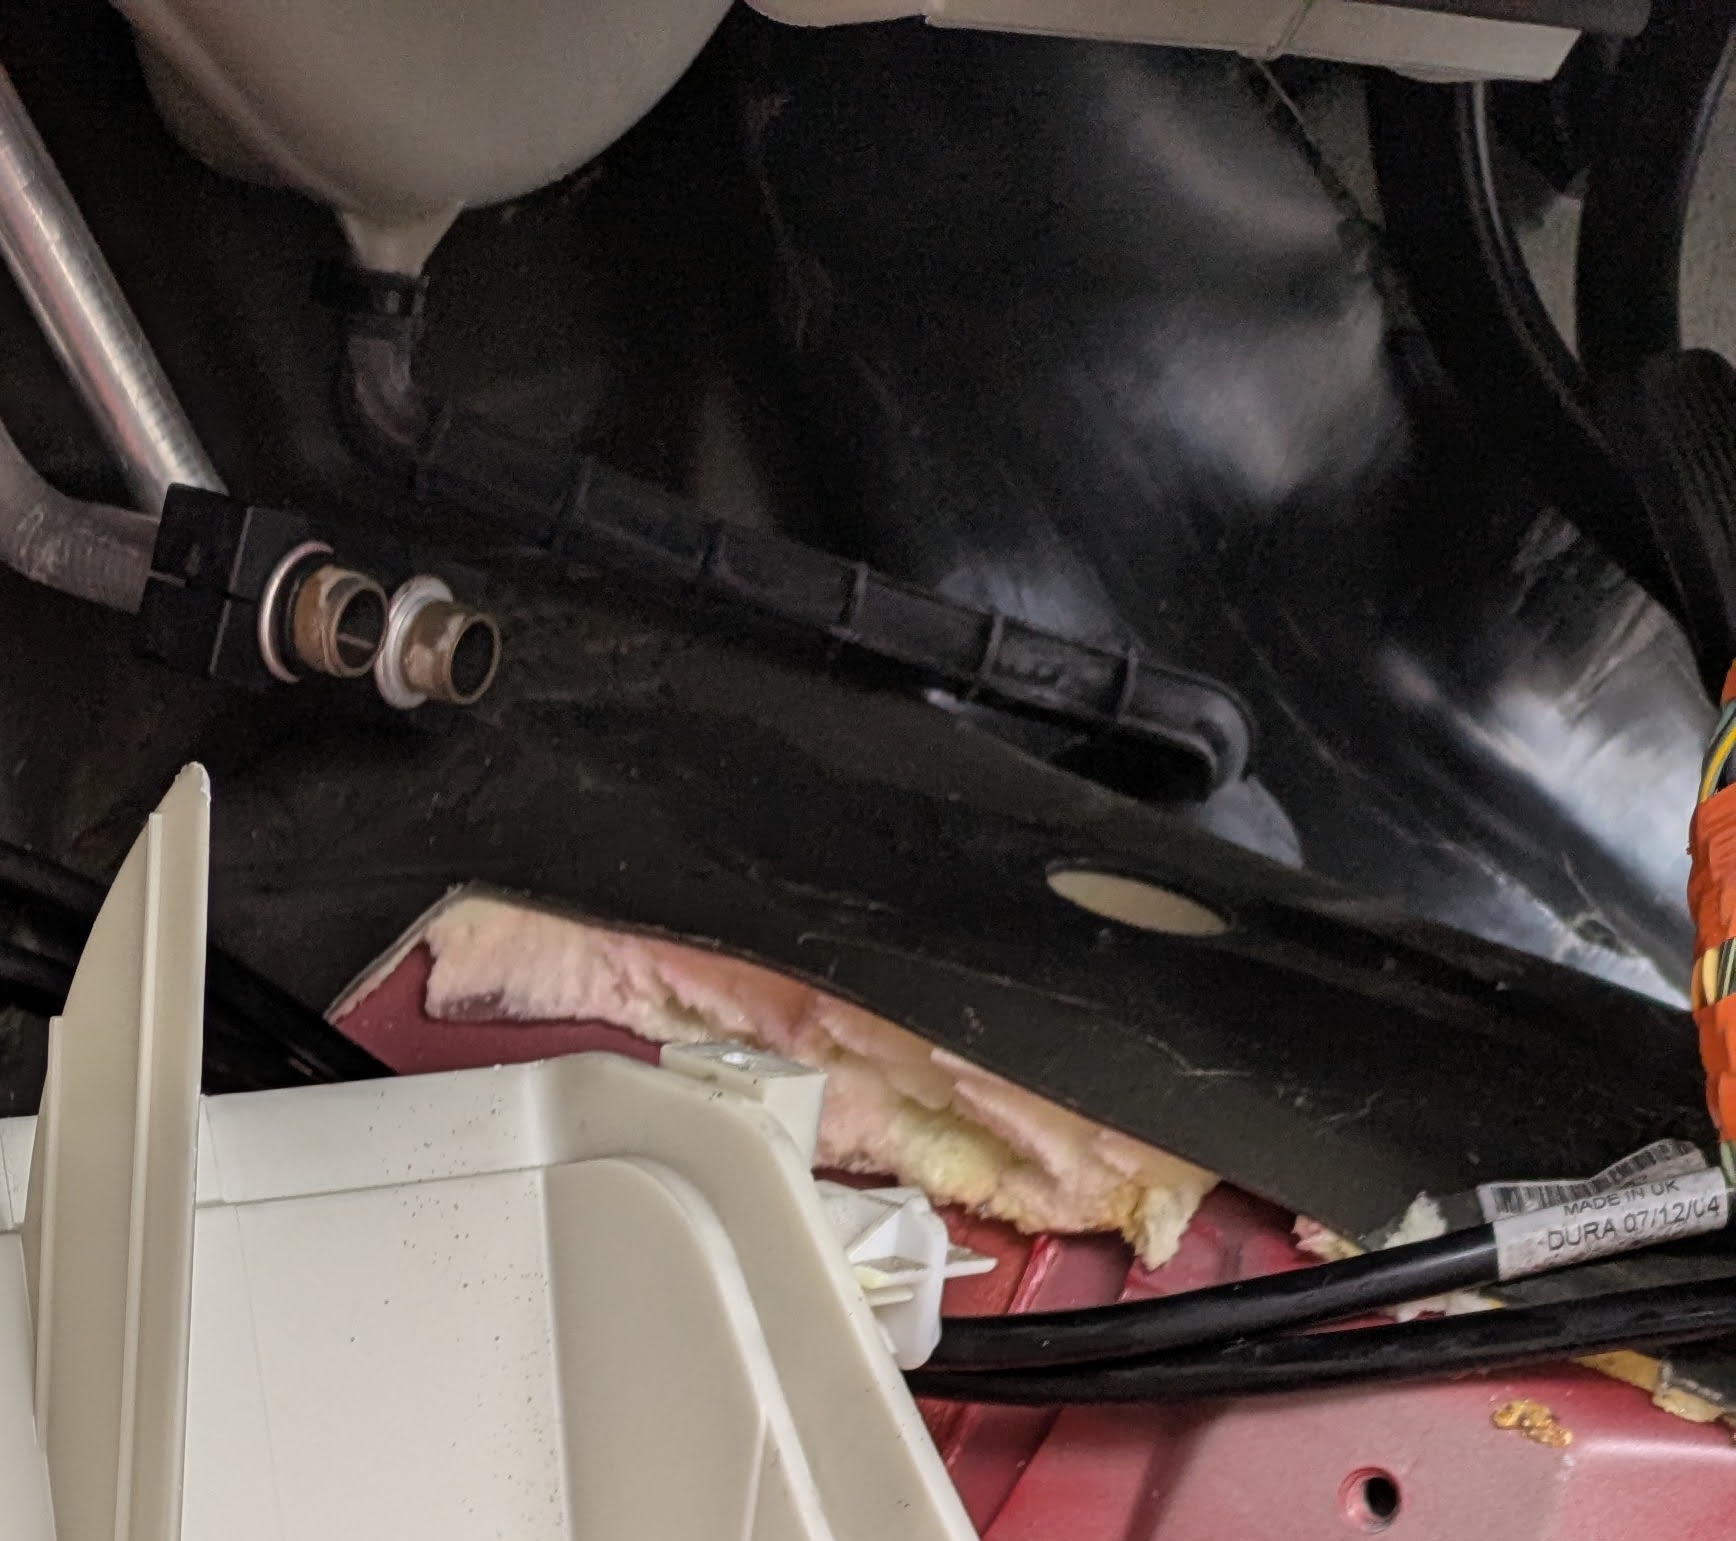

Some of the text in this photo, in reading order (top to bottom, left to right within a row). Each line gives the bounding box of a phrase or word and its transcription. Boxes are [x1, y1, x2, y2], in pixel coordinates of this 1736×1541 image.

[1563, 1195, 1621, 1216] MADE
[1626, 1188, 1646, 1204] IN
[1650, 1179, 1680, 1197] UK
[1547, 1196, 1721, 1251] DURA 07/12/04
